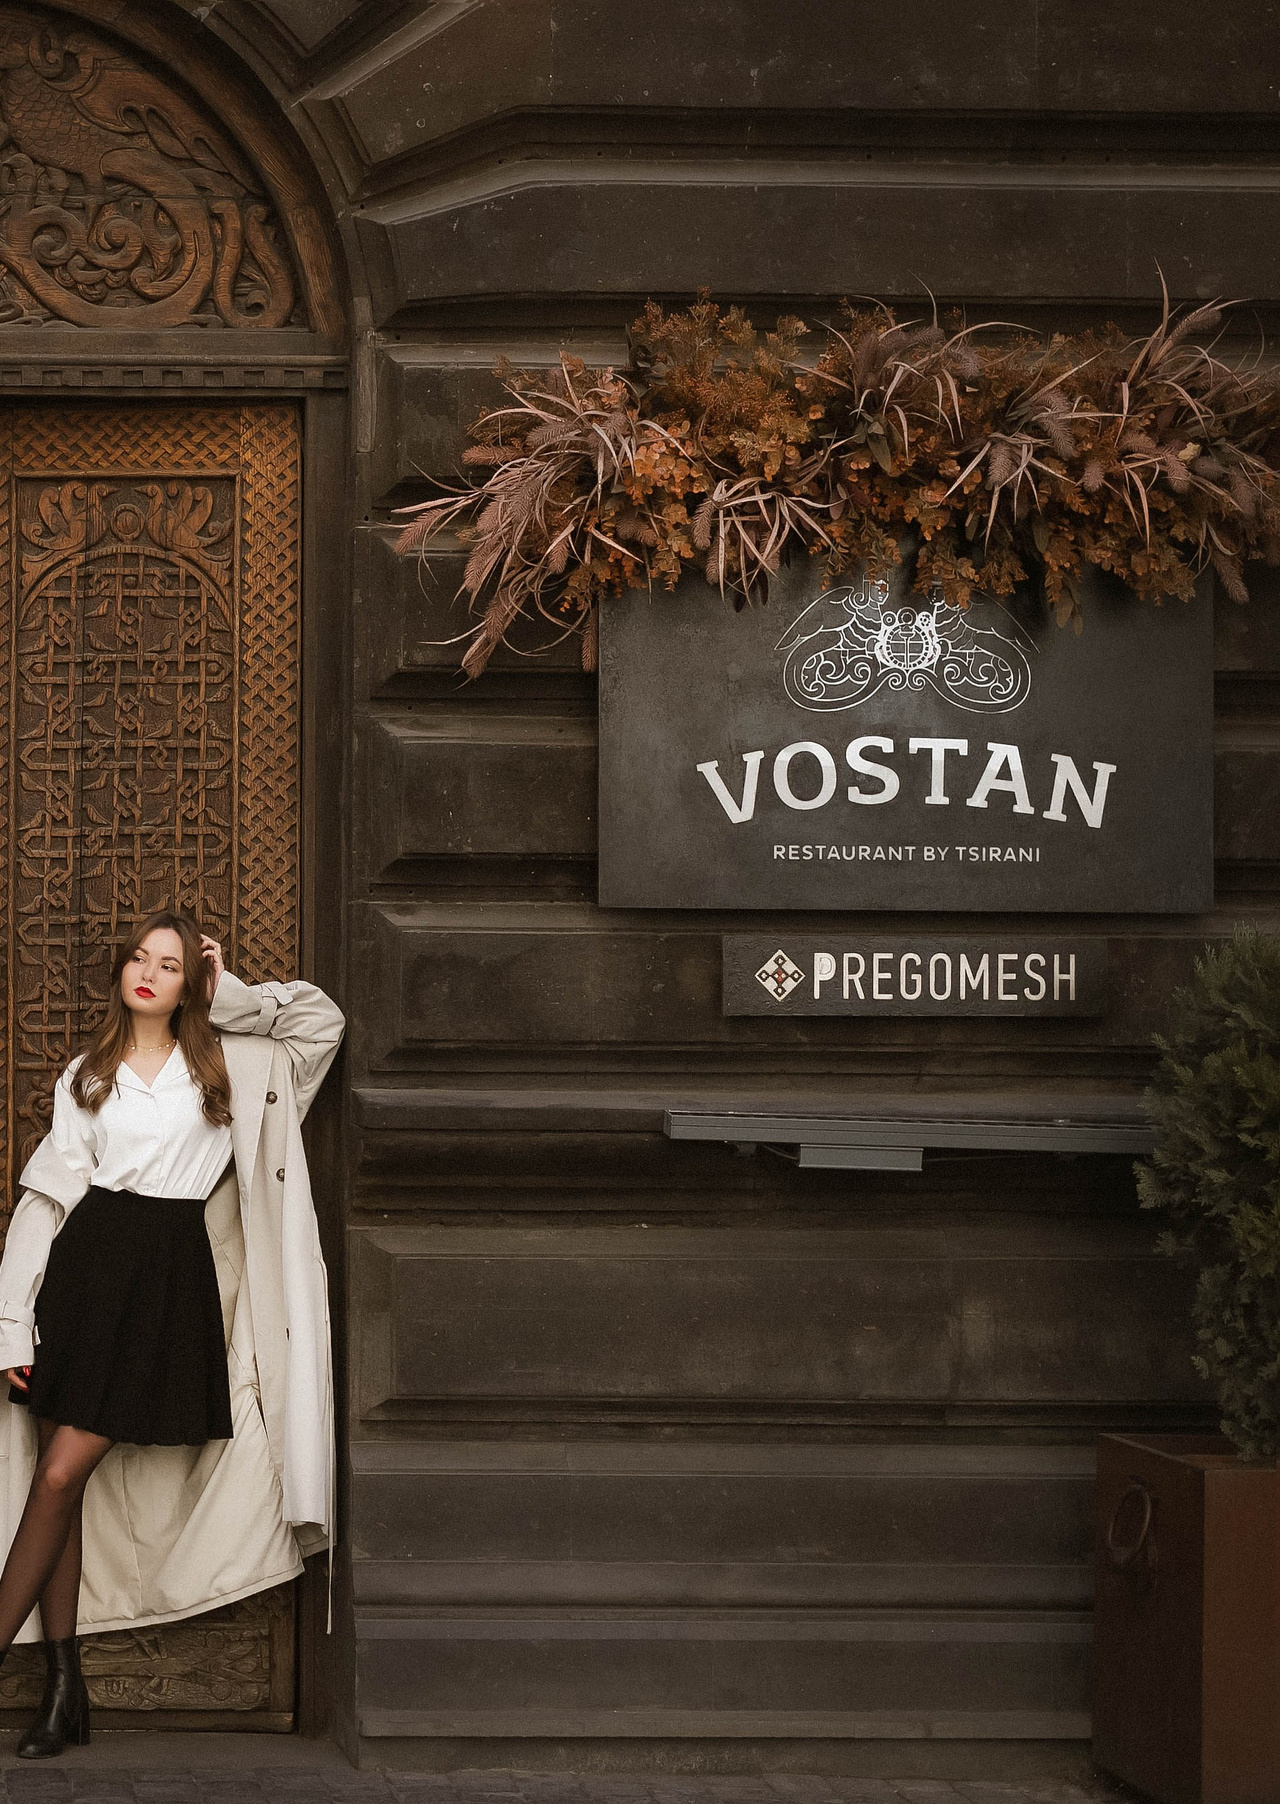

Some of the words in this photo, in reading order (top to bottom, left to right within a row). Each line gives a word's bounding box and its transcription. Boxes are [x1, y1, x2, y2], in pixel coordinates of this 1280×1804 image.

[696, 735, 1117, 829] VOSTAN
[773, 844, 917, 861] RESTAURANT
[923, 846, 950, 861] BY
[954, 846, 1041, 862] TSIRANI
[813, 952, 1076, 1001] PREGOMESH
